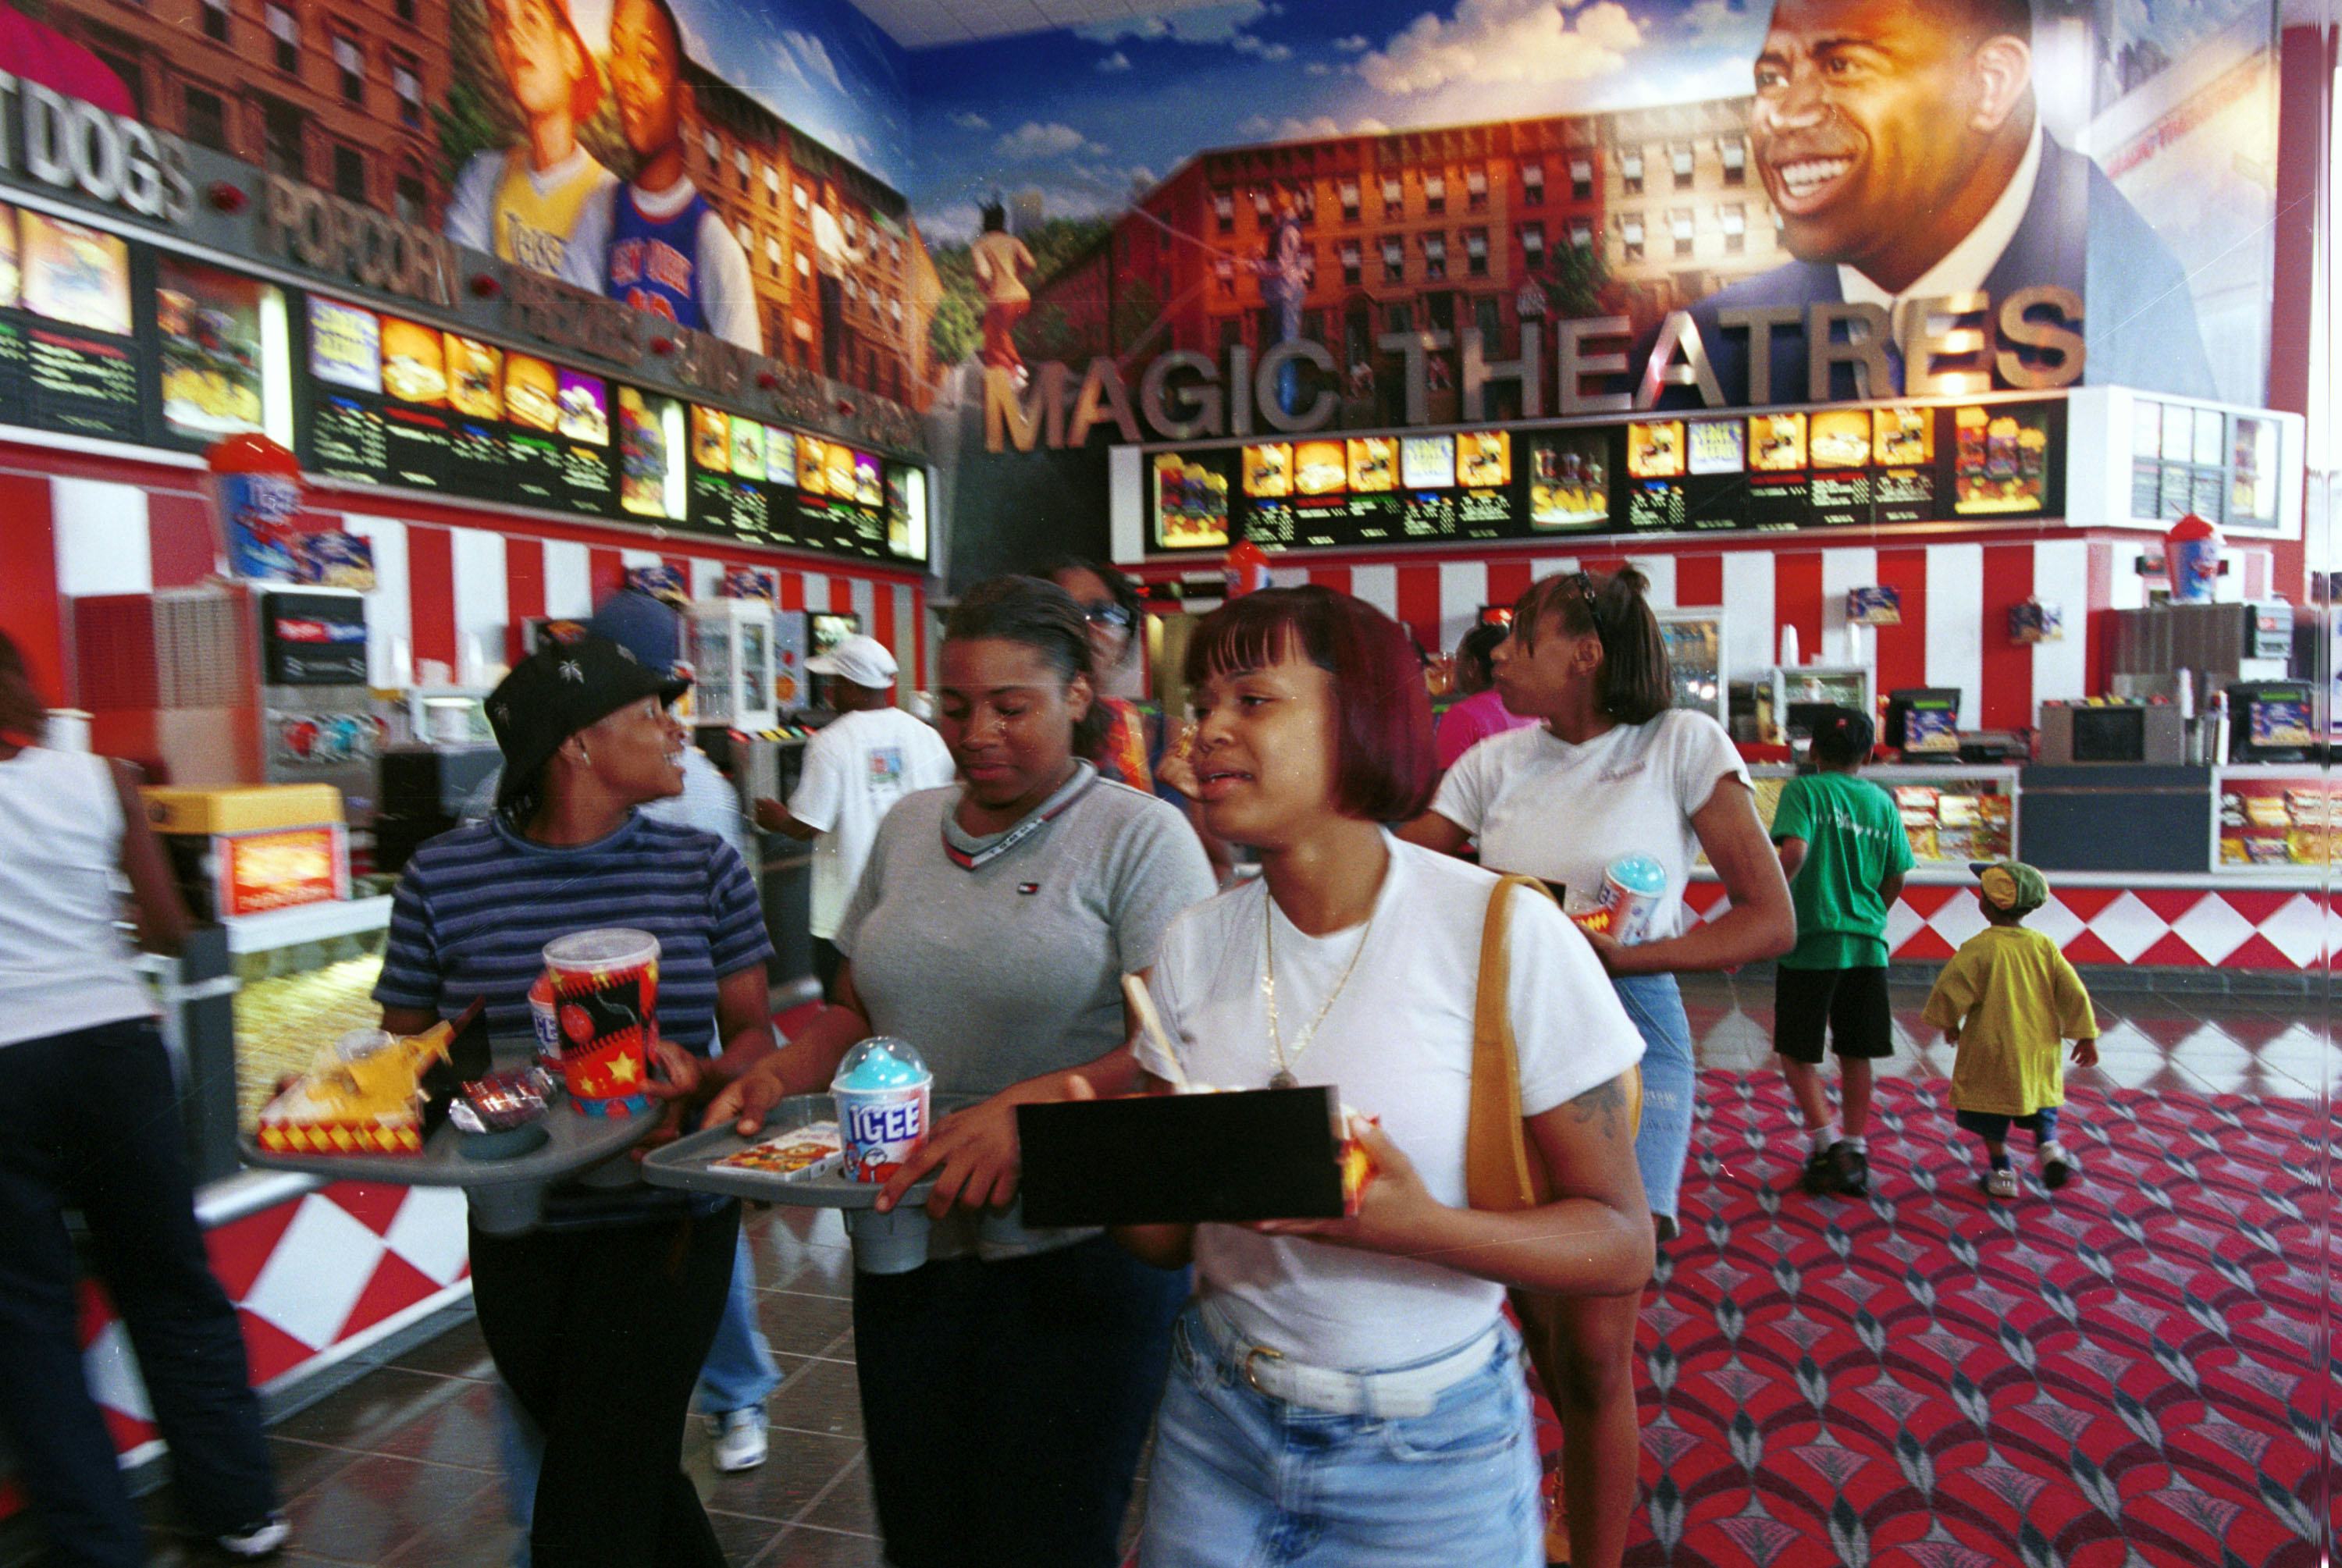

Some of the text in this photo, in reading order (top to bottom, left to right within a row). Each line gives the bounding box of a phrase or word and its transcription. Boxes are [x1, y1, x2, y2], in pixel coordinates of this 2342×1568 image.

[22, 76, 195, 226] DOGS
[983, 340, 1341, 453] MAGIC
[1378, 286, 2088, 426] THEATRES
[849, 1097, 921, 1145] ICEE
